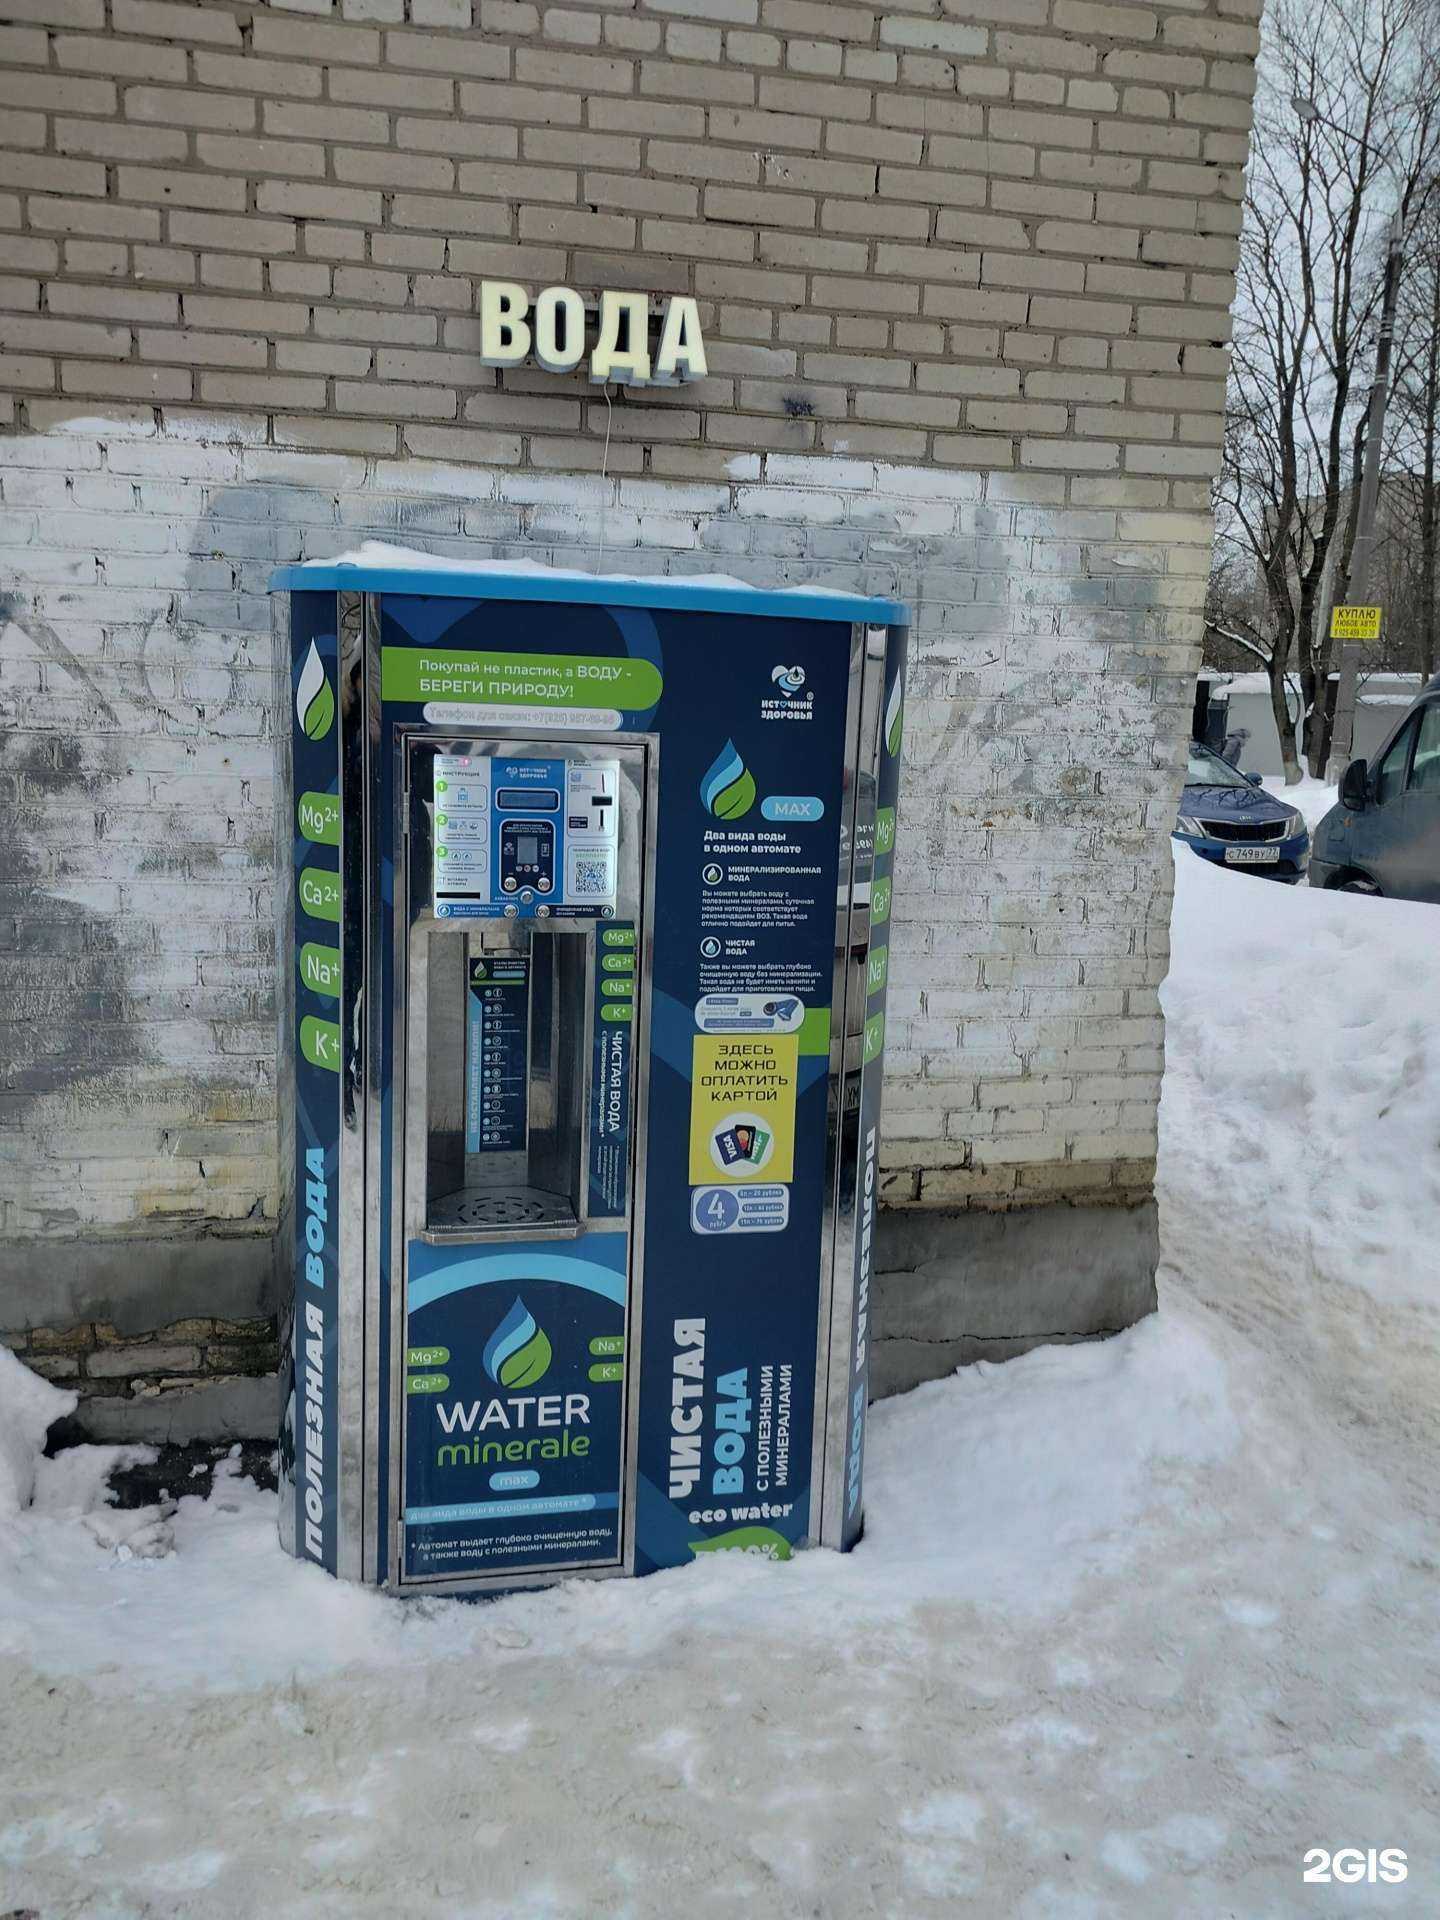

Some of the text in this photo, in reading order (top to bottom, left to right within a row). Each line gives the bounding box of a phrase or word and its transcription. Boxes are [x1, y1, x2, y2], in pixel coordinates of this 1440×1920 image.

[480, 280, 708, 387] ВОДА
[1338, 608, 1376, 619] КУПЛЮ
[419, 659, 480, 674] Покупай
[484, 664, 501, 675] не
[504, 666, 562, 678] пластик,
[566, 669, 573, 677] а
[577, 665, 622, 681] ВОДУ
[419, 678, 575, 699] БЕРЕГИ ПРИРОДУ!
[761, 710, 813, 721] ЗДОРОВЬЯ
[774, 802, 811, 816] MAX
[703, 830, 786, 842] Два вида воды
[703, 844, 802, 854] в одном автомате
[727, 866, 822, 874] МИНЕРАЛИЗИРОВАННАЯ
[728, 874, 751, 883] ВОДА
[725, 948, 748, 956] ВОДА
[718, 1044, 774, 1056] ЗДЕСЬ
[611, 1031, 624, 1093] ЧИСТАЯ
[714, 1060, 777, 1071] МОЖНО
[701, 1075, 788, 1086] ОПЛАТИТЬ
[711, 1087, 777, 1102] КАРТОЙ
[608, 1095, 622, 1132] ВОДА
[707, 1193, 725, 1220] 4
[305, 1148, 327, 1560] ПОЛЕЗНАЯ ВОДА
[436, 1393, 590, 1434] WATER
[669, 1317, 706, 1499] ЧИСТАЯ
[713, 1367, 752, 1495] ВОДА
[756, 1365, 774, 1492] С ПОЛЕЗНЫМИ
[775, 1364, 793, 1487] МИНЕРАЛАМИ
[437, 1429, 590, 1468] minerale
[499, 1474, 529, 1487] max
[688, 1502, 793, 1525] eco water
[417, 1540, 458, 1551] Автомат
[459, 1537, 494, 1548] выдает
[495, 1533, 532, 1546] глубоко
[533, 1529, 587, 1540] очищенную
[588, 1527, 613, 1538] воду,
[430, 1550, 459, 1561] также
[460, 1548, 484, 1558] воду
[485, 1547, 490, 1555] с
[491, 1544, 542, 1555] полезными
[543, 1539, 601, 1550] минералами.
